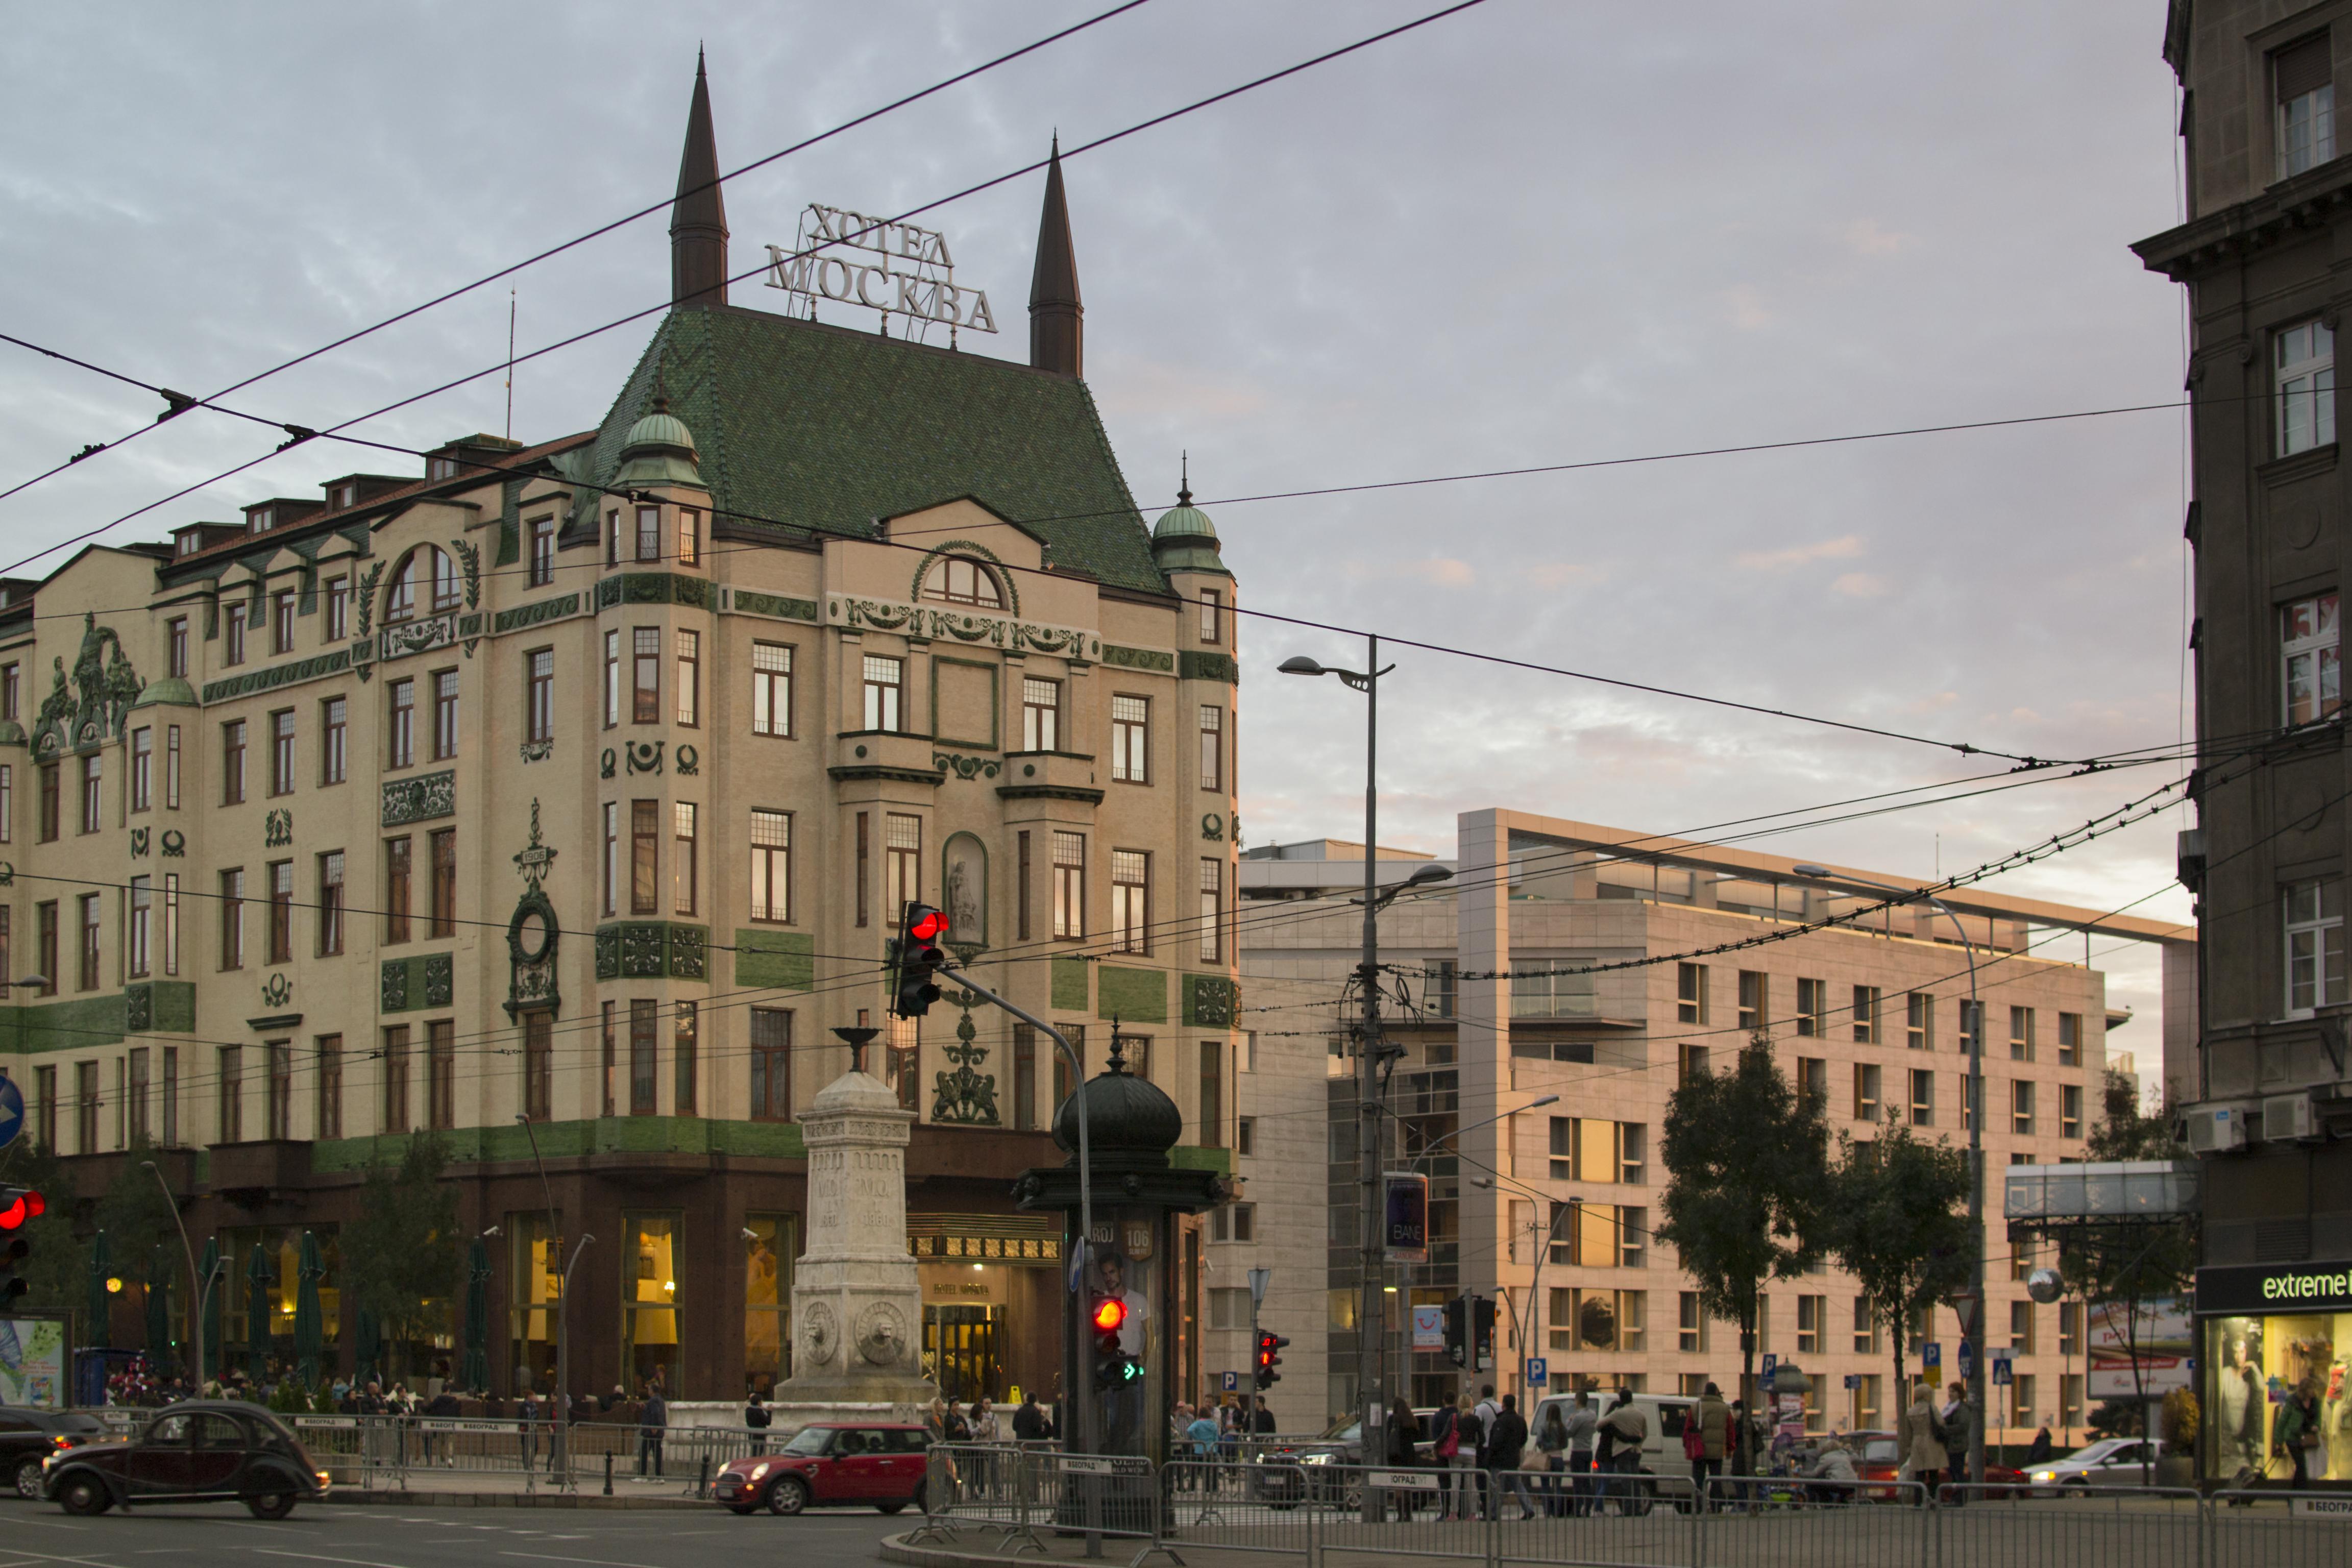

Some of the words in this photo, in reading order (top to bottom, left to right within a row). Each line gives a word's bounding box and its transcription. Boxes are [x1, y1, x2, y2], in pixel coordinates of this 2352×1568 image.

[807, 202, 955, 268] ХОТЕЛ
[764, 243, 999, 334] МОСКВА
[524, 850, 545, 862] 1906
[1090, 1227, 1114, 1243] ROJ
[1127, 1230, 1149, 1247] 106
[1393, 1224, 1422, 1241] BANE
[934, 1283, 956, 1294] HOTEL
[1927, 1346, 1937, 1362] P
[1531, 1360, 1542, 1379] P
[1765, 1356, 1774, 1376] P
[1225, 1373, 1234, 1389] P
[1071, 1461, 1095, 1470] БЕОГРАД
[1391, 1475, 1415, 1485] ОГРАД
